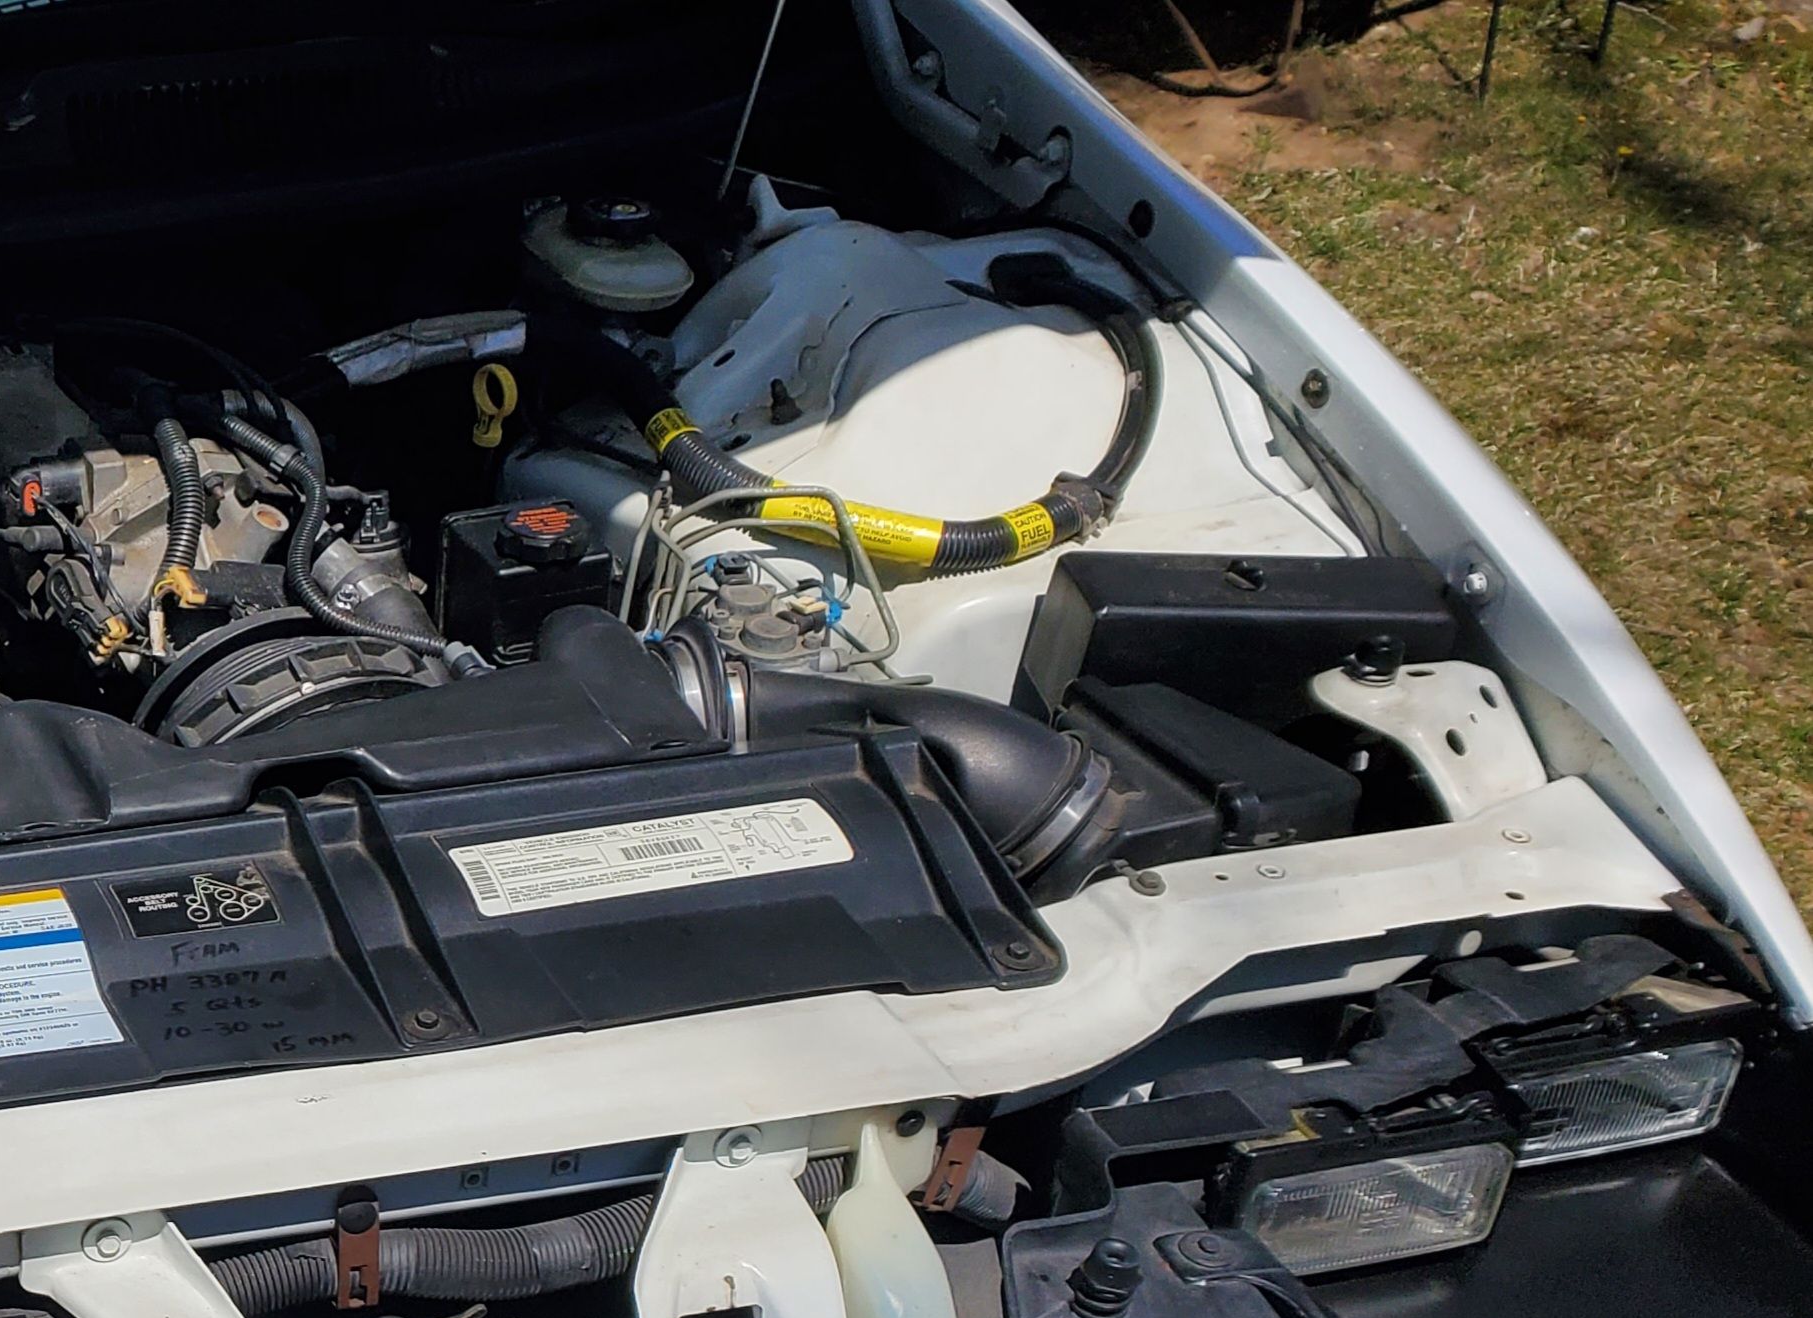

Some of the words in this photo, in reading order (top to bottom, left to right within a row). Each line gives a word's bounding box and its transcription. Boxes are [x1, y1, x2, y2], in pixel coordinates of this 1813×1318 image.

[1014, 512, 1046, 527] CAUTION
[1021, 524, 1050, 541] FUEL
[631, 818, 696, 832] CATALYST
[126, 891, 180, 904] ACCESSORY
[144, 898, 167, 906] BELT
[138, 901, 179, 912] ROUTING
[130, 975, 168, 997] PH
